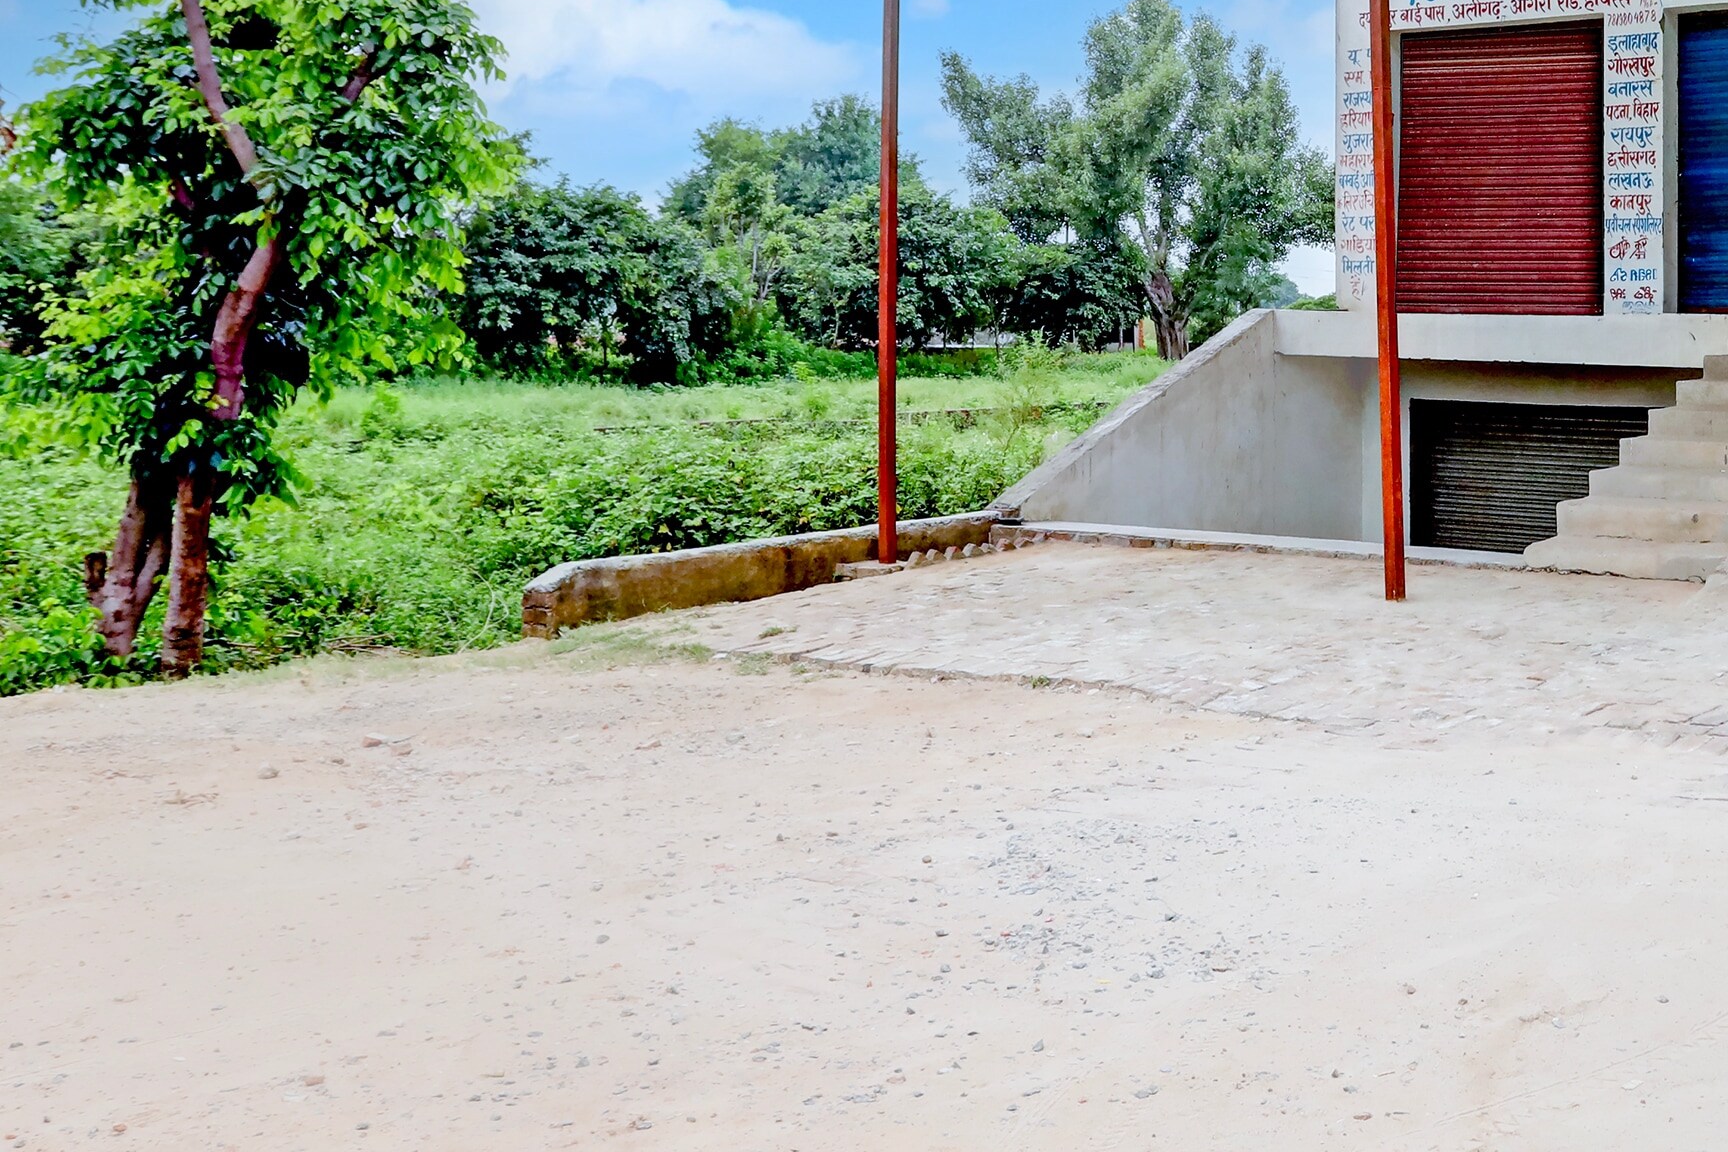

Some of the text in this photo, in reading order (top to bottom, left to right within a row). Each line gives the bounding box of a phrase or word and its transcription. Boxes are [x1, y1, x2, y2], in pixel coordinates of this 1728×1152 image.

[1607, 53, 1656, 77] गोरखपुर
[1610, 126, 1656, 148] रायपुर
[1608, 172, 1654, 190] लखनऊ
[1610, 194, 1653, 215] कानपुर
